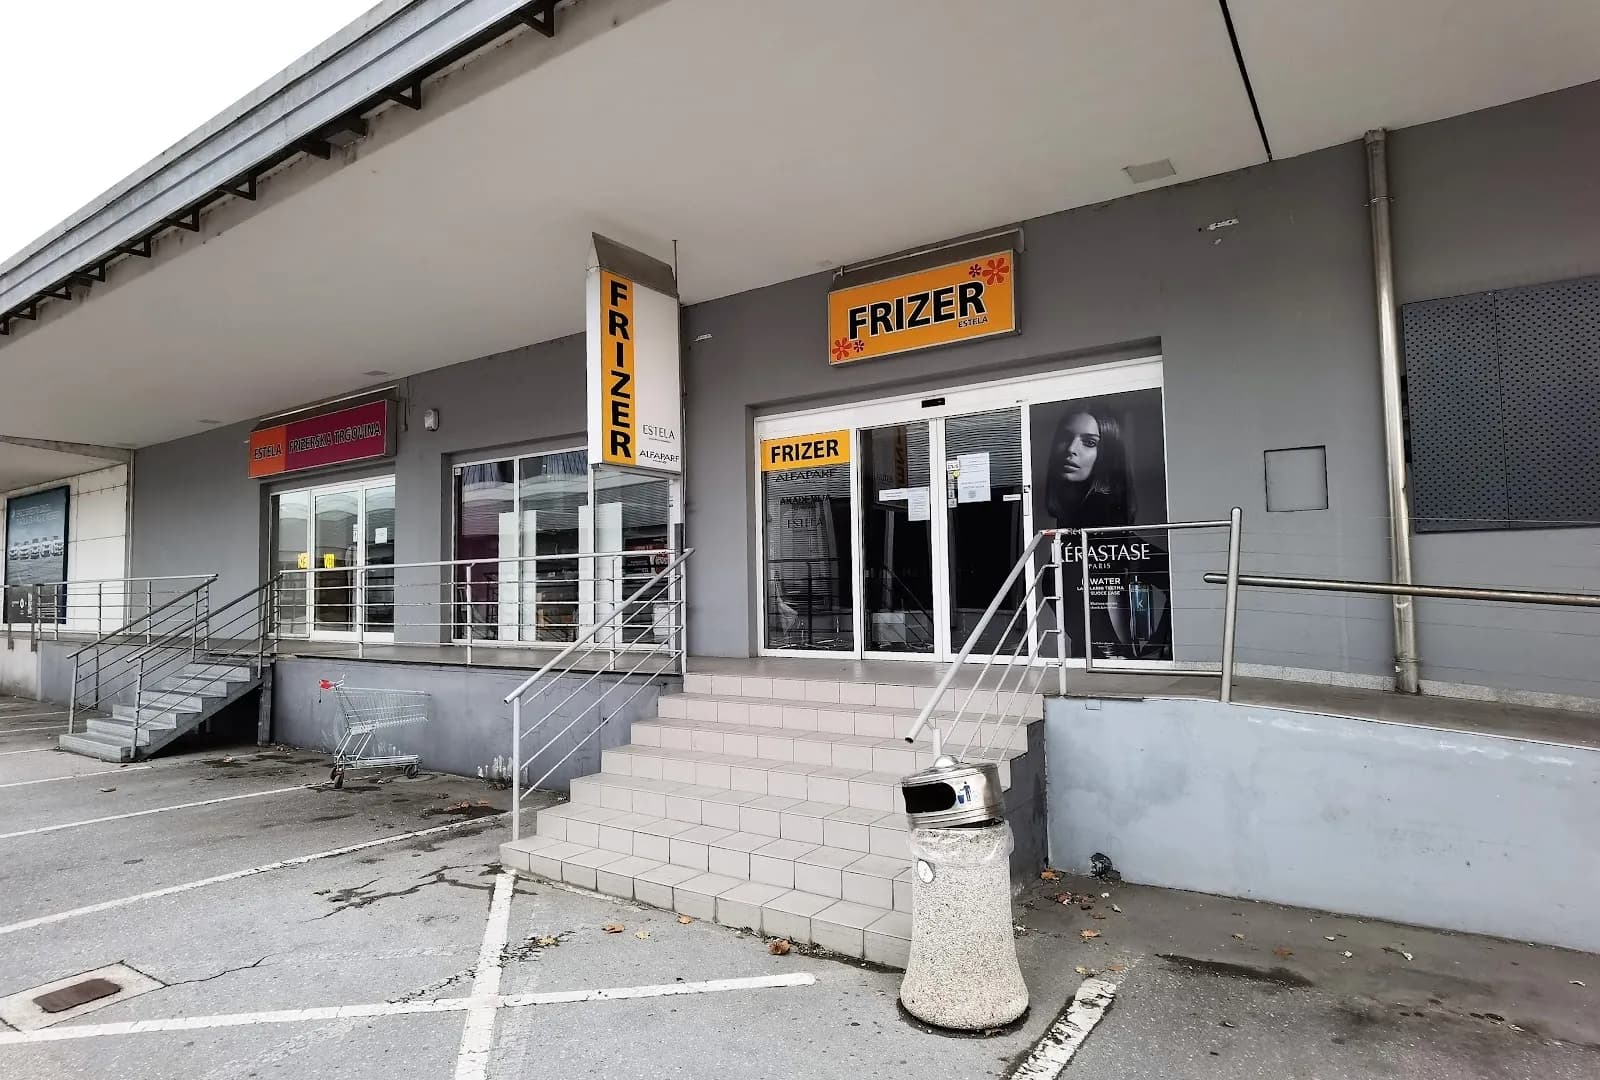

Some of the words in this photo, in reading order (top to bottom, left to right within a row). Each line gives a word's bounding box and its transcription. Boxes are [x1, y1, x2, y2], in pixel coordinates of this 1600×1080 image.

[848, 281, 986, 341] FRIZER
[958, 314, 988, 328] ESTELA
[609, 280, 632, 458] FRIZER
[254, 443, 282, 461] ESTELA
[288, 431, 333, 454] FRIZERSKA
[334, 421, 381, 445] TRGOVINA
[642, 425, 676, 440] ESTELA
[771, 439, 839, 463] FRIZER
[1090, 577, 1121, 585] WATER
